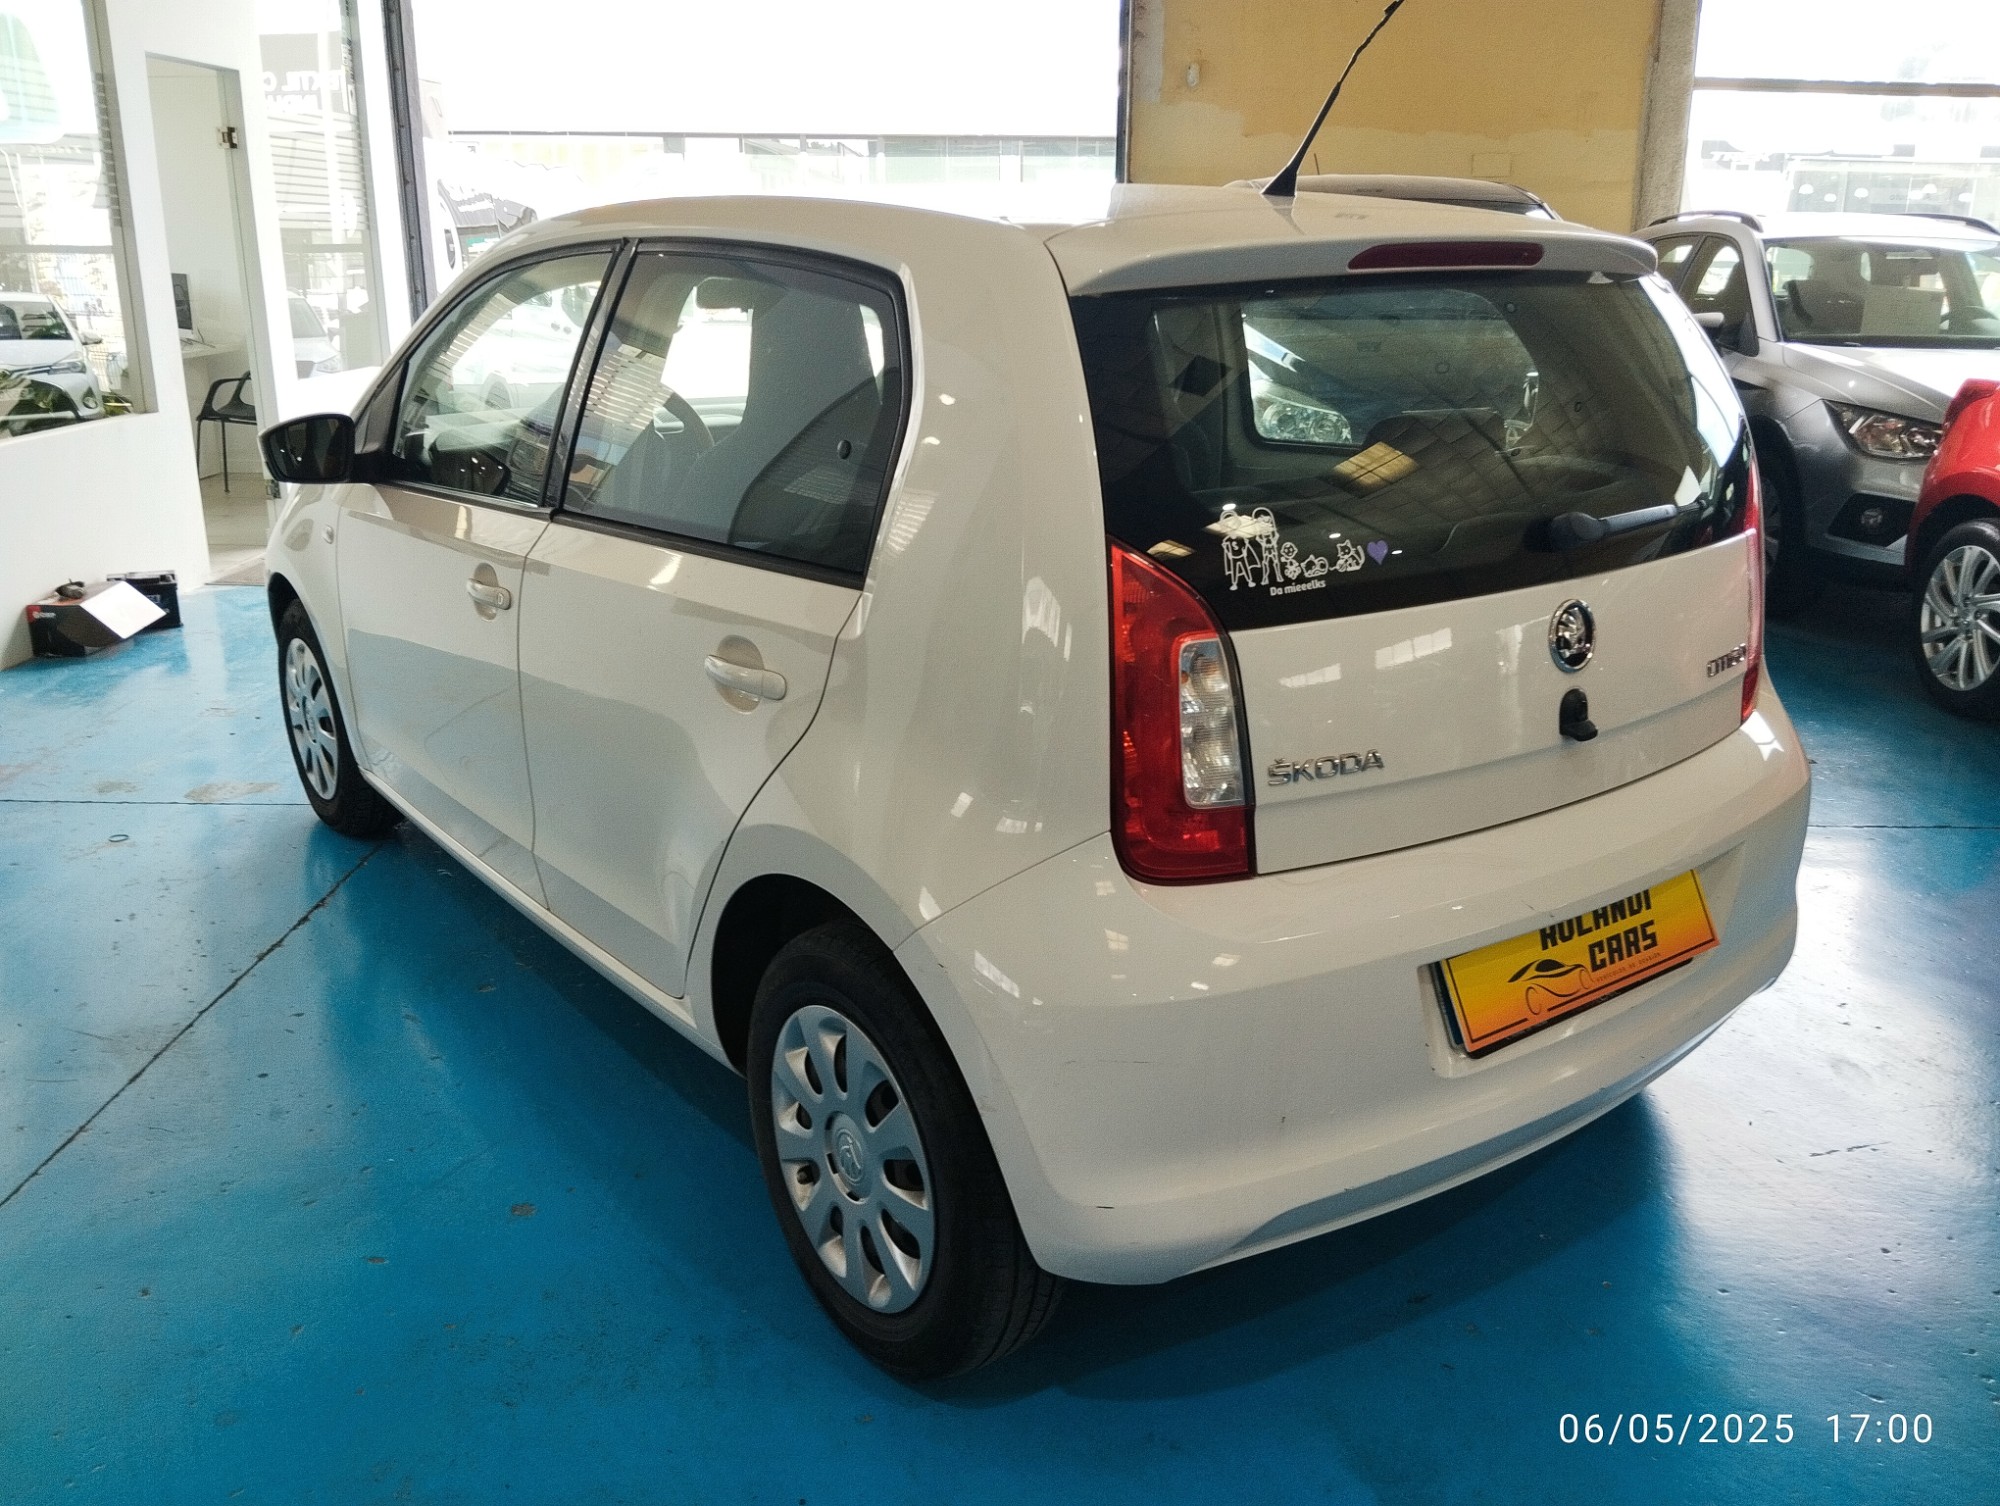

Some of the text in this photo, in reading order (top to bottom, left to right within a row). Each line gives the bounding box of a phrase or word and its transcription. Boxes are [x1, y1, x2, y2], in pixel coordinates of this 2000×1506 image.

[1232, 541, 1239, 550] S
[1270, 586, 1283, 596] Da
[1268, 749, 1384, 787] ŠKODA
[1588, 919, 1658, 973] CARS
